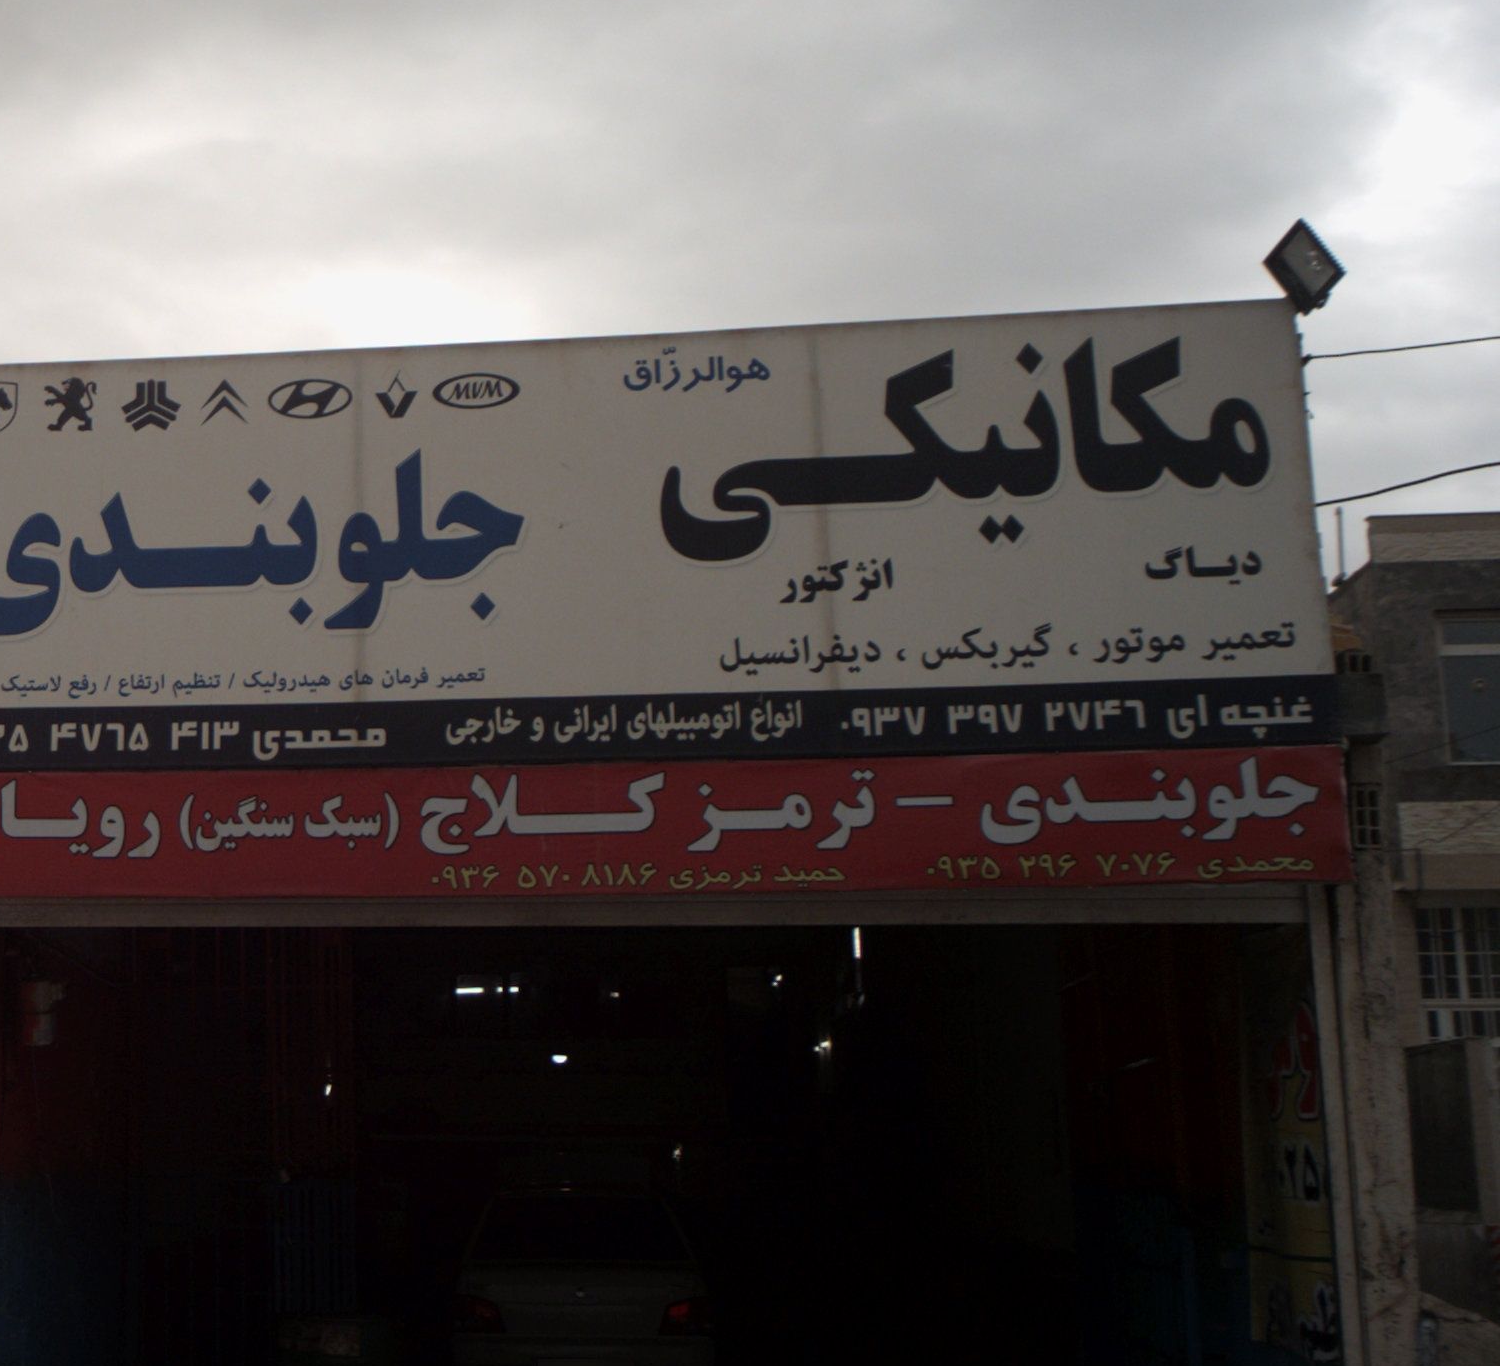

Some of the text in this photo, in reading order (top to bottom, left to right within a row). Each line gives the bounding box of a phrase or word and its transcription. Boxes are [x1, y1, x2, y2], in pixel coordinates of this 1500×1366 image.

[660, 336, 1270, 562] مکانیکی
[780, 546, 1262, 603] دیاگ انژکتور
[718, 635, 881, 673] دیفرانسیل
[921, 623, 1052, 668] گیربکس
[1093, 634, 1186, 664] موتور
[1202, 620, 1296, 659] تعمیر
[0, 674, 62, 697] لاستیک
[67, 674, 98, 699] رفع
[117, 674, 166, 696] ارتفاع
[172, 672, 221, 696] تنظیم
[242, 671, 332, 694] هیدرولیک
[339, 669, 374, 691] های
[381, 667, 430, 690] فرمان
[436, 667, 486, 689] تعمیر
[445, 698, 804, 745] انواع اتومبیلهای ایرانی و خارجی
[947, 703, 1023, 735] ۳۹۷
[1166, 694, 1209, 740] ای
[1220, 695, 1314, 739] غنچه
[252, 726, 388, 762] محمدی
[420, 771, 666, 856] کلاج
[687, 769, 877, 852] ترمز
[981, 756, 1320, 845] جلوبندی
[668, 864, 762, 891] ترمزی
[772, 864, 847, 888] حمید
[1198, 855, 1316, 880] محمدی
